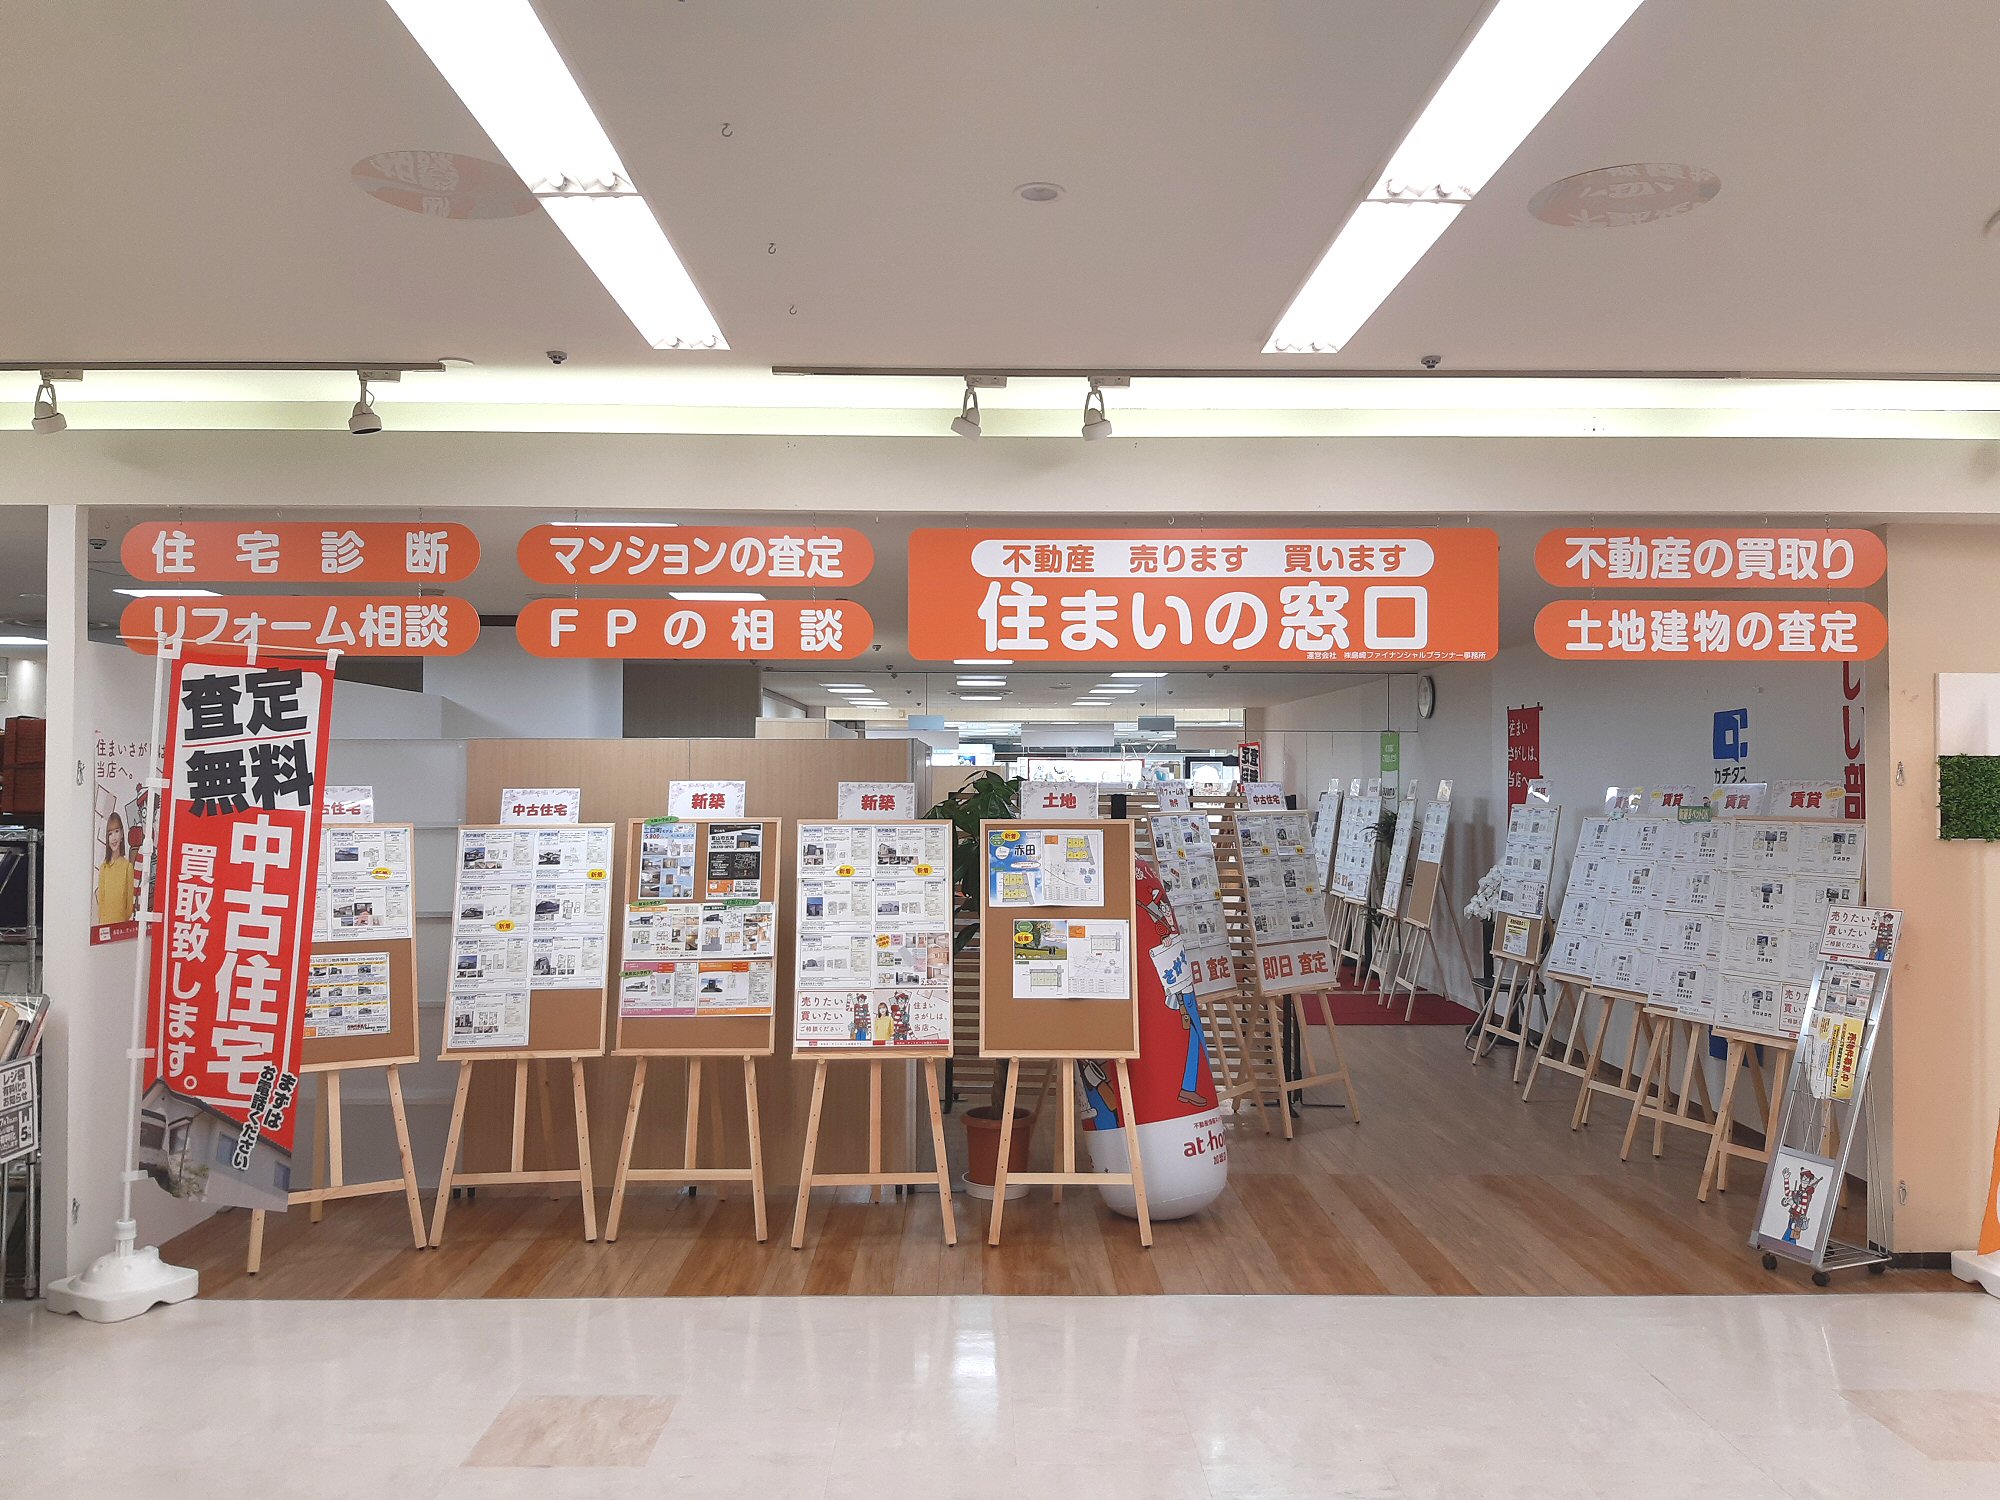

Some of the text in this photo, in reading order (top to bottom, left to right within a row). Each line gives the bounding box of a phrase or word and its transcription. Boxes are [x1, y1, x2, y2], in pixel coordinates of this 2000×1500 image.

[152, 531, 448, 575] 住宅診断
[550, 536, 844, 579] マンションの査定
[1002, 544, 1407, 573] 不動産 売ります 買います
[1566, 537, 1855, 582] 不動産の買取り
[154, 603, 448, 647] リフォーム相談
[977, 581, 1428, 652] 住まいの窓口
[551, 609, 843, 652] FPの相談
[1568, 610, 1857, 655] 土地建物の査定
[182, 667, 308, 741] 査定
[97, 760, 133, 780] 当店へ。
[185, 739, 315, 818] 無料
[1714, 766, 1747, 784] カチタス
[512, 803, 568, 818] 中古住宅
[691, 793, 726, 810] 新築
[861, 794, 896, 811] 新築
[1042, 793, 1077, 809] 土地
[1253, 795, 1280, 805] 中古住宅
[1724, 794, 1751, 810] 賃貸
[1790, 791, 1823, 809] 賃貸
[1014, 844, 1036, 856] 赤田
[1830, 911, 1870, 922] 売りたい
[1827, 925, 1867, 937] 買いたい
[167, 842, 218, 1090] 買取致します。
[207, 813, 294, 1096] 中古住宅
[1262, 950, 1329, 981] 即日 査定
[1206, 955, 1231, 982] 査定
[800, 996, 844, 1007] 売りたい
[800, 1011, 844, 1021] 買いたい
[264, 1072, 297, 1130] まずは
[1183, 1136, 1206, 1158] at
